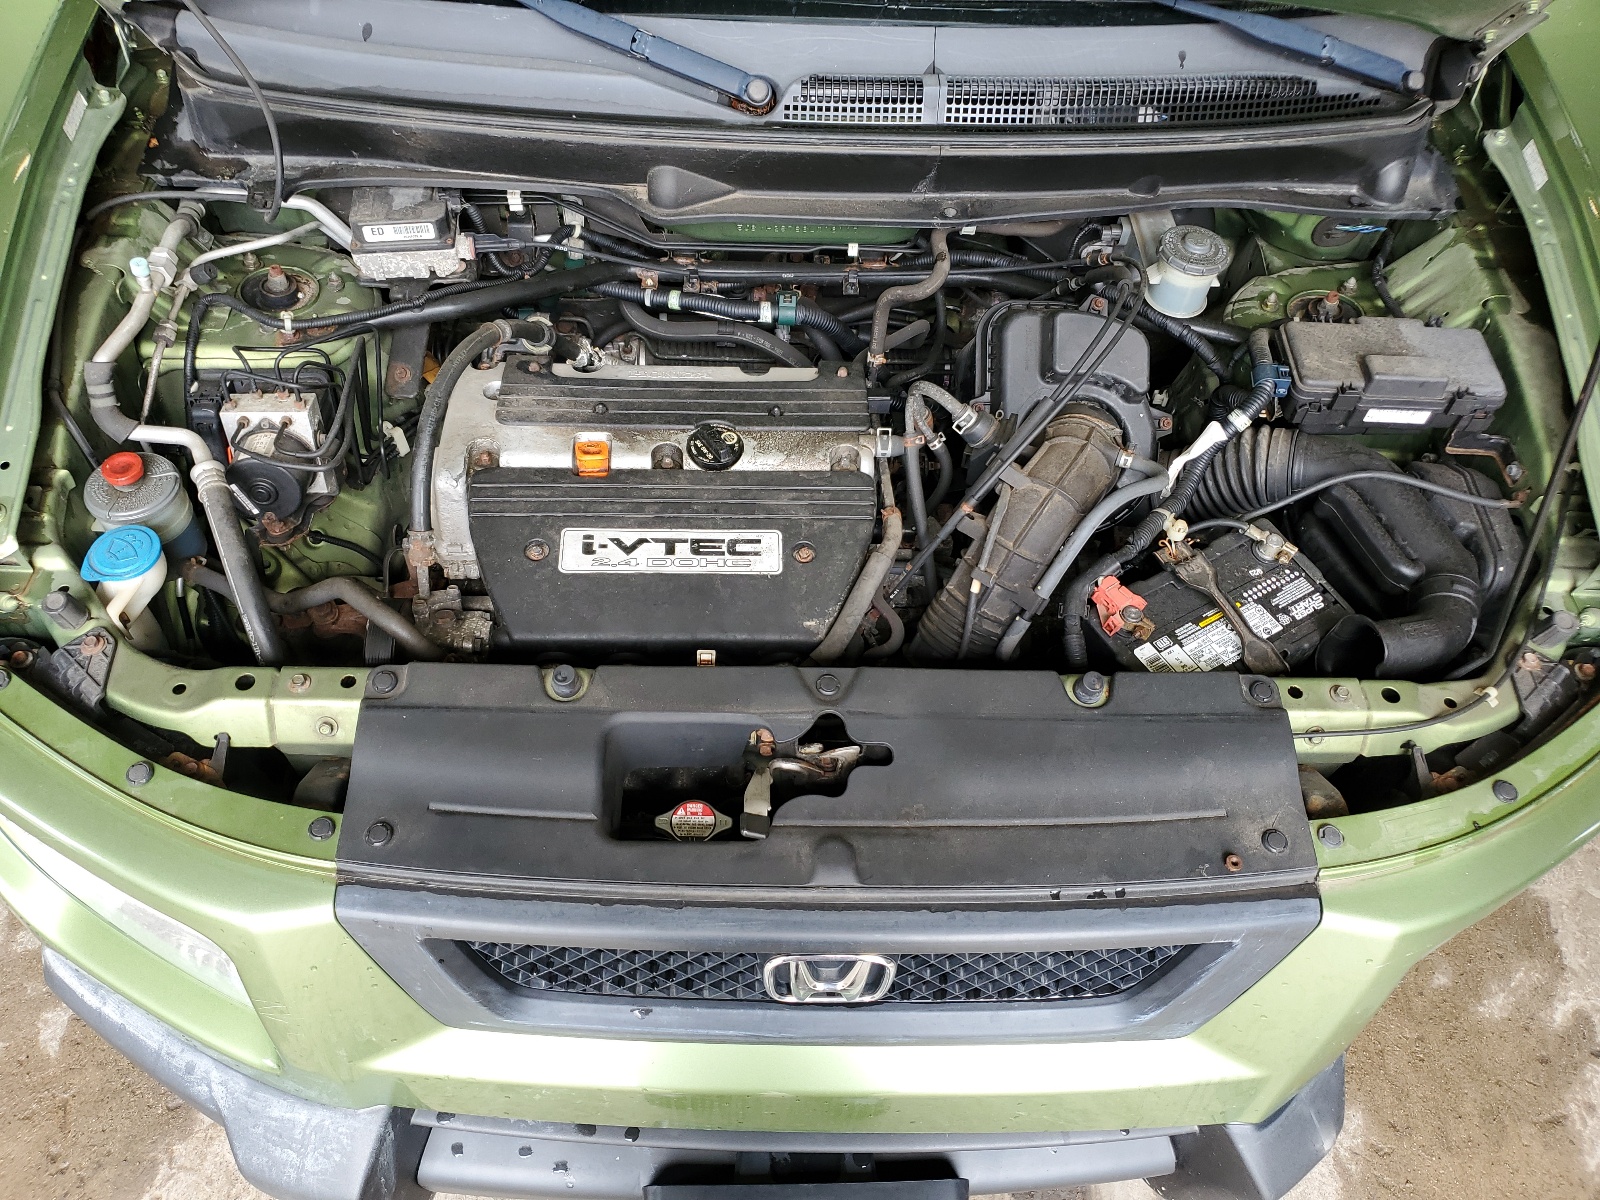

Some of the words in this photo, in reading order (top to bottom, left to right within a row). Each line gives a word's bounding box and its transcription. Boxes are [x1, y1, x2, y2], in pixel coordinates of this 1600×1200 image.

[371, 227, 384, 236] ED
[590, 557, 640, 568] 2.4
[646, 557, 752, 568] DOHC
[1289, 593, 1324, 614] START
[1293, 600, 1325, 621] SUPER
